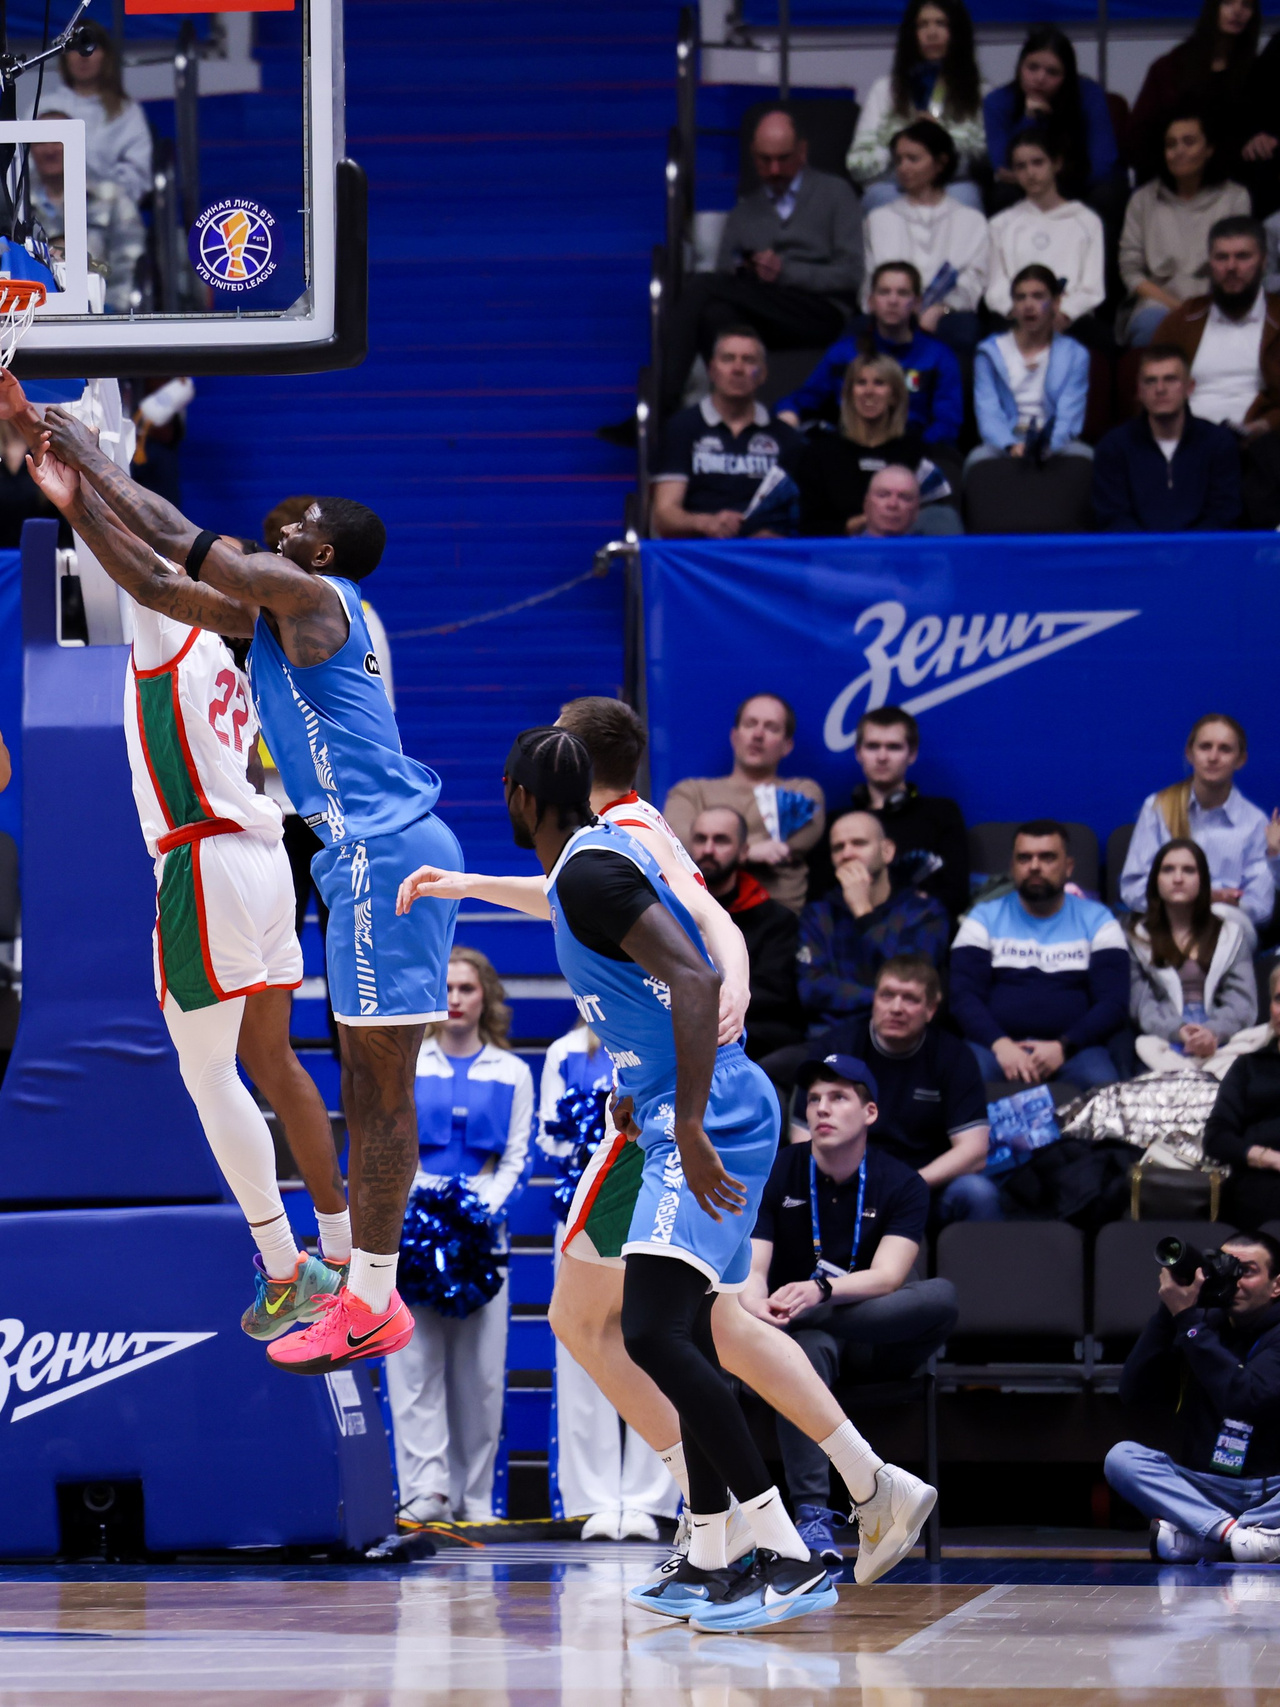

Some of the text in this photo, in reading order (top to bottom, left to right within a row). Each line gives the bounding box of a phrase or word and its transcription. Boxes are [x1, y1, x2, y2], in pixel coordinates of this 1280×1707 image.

[195, 199, 276, 228] ЕДИНАЯ ЛИГА ВТБ
[196, 261, 277, 292] VTB UNITED LEAGUE
[823, 600, 1142, 753] Зенит
[208, 668, 249, 754] 22
